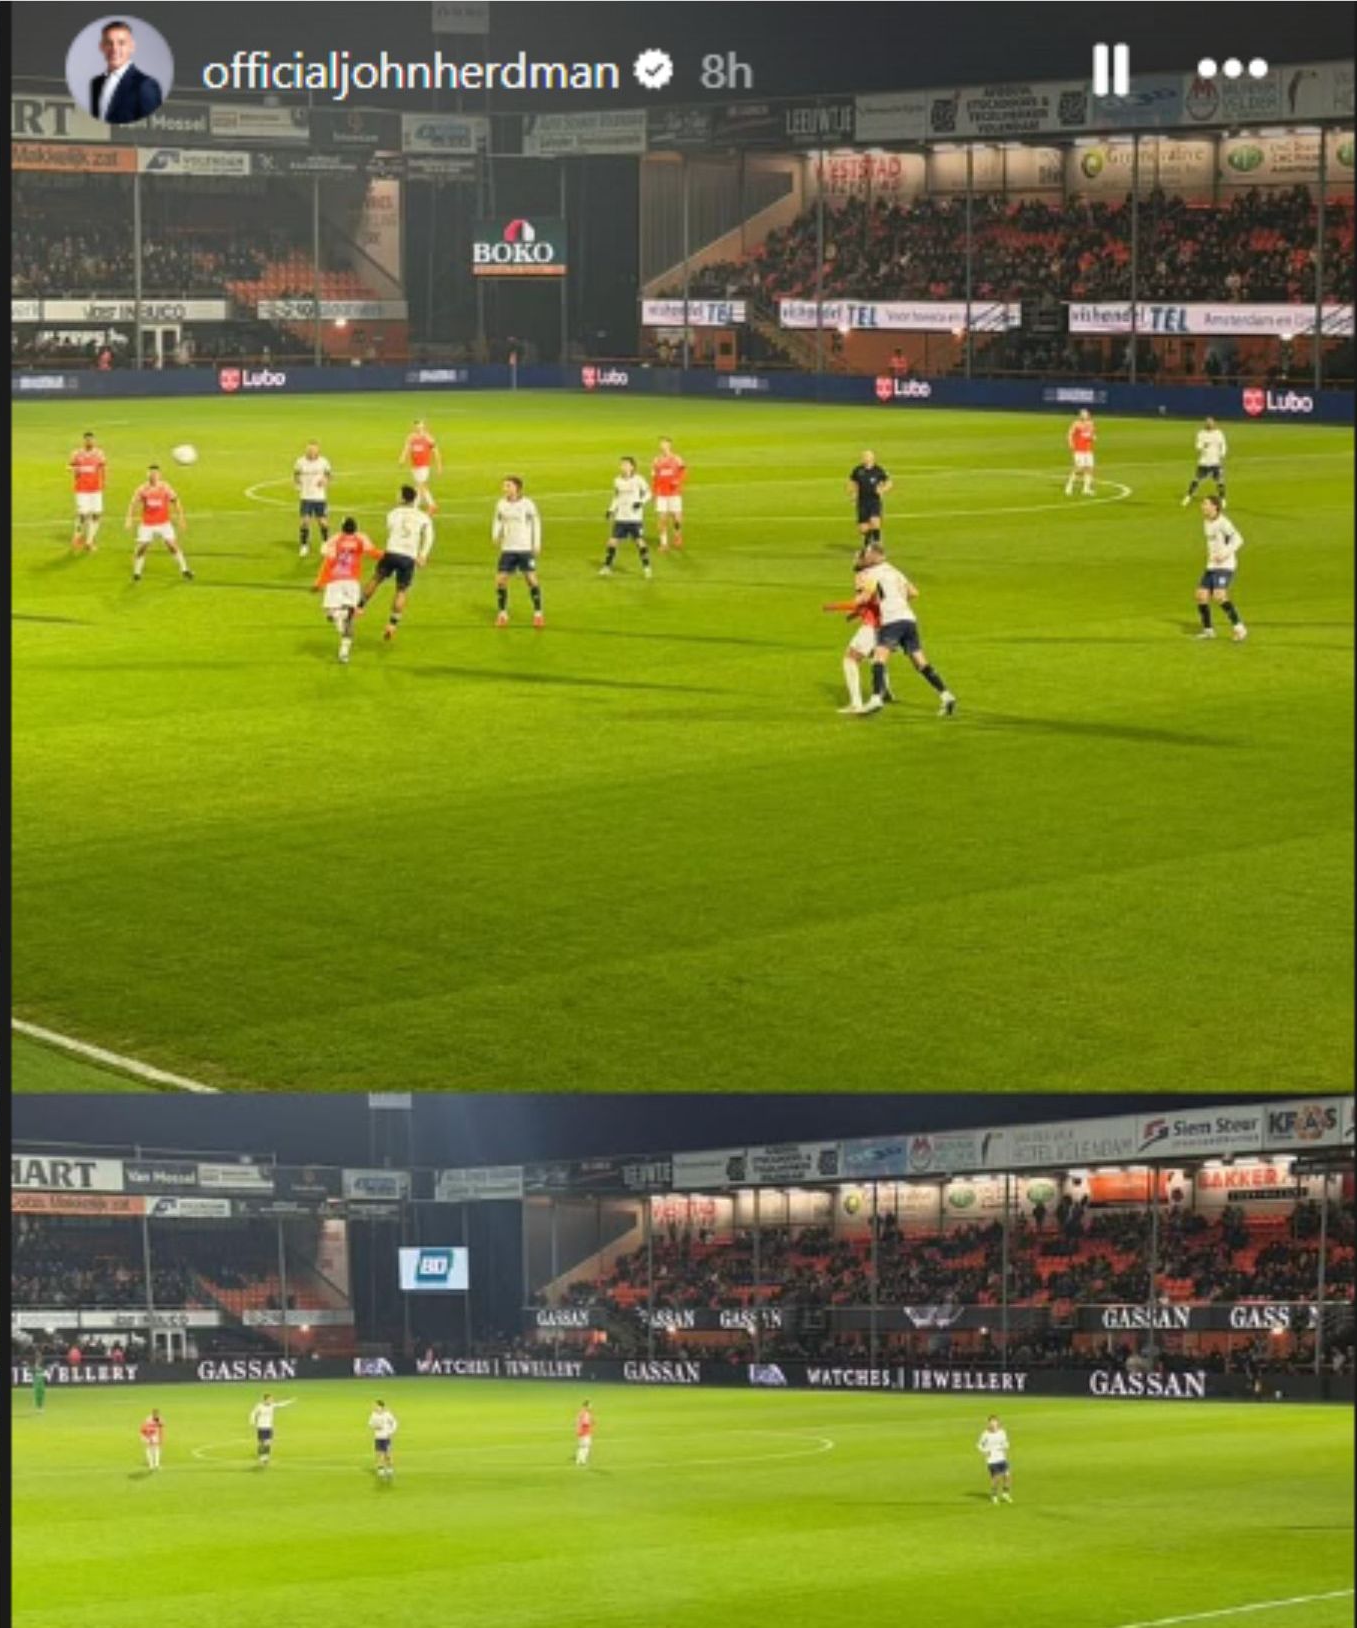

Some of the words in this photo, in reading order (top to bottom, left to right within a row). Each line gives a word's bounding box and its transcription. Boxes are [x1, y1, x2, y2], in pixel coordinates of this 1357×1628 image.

[472, 242, 554, 264] BOKO
[847, 304, 878, 327] TEL
[1149, 305, 1190, 332] TEL
[242, 369, 287, 387] Lubo
[597, 370, 629, 386] Lubo
[894, 378, 932, 398] Lubo
[1267, 390, 1314, 413] Lubo
[197, 1358, 298, 1381] GASSAN
[623, 1361, 701, 1384] GASSAN
[806, 1367, 891, 1387] WATCHES
[912, 1369, 1029, 1391] JEWELLERY
[1089, 1369, 1208, 1398] GASSAN
